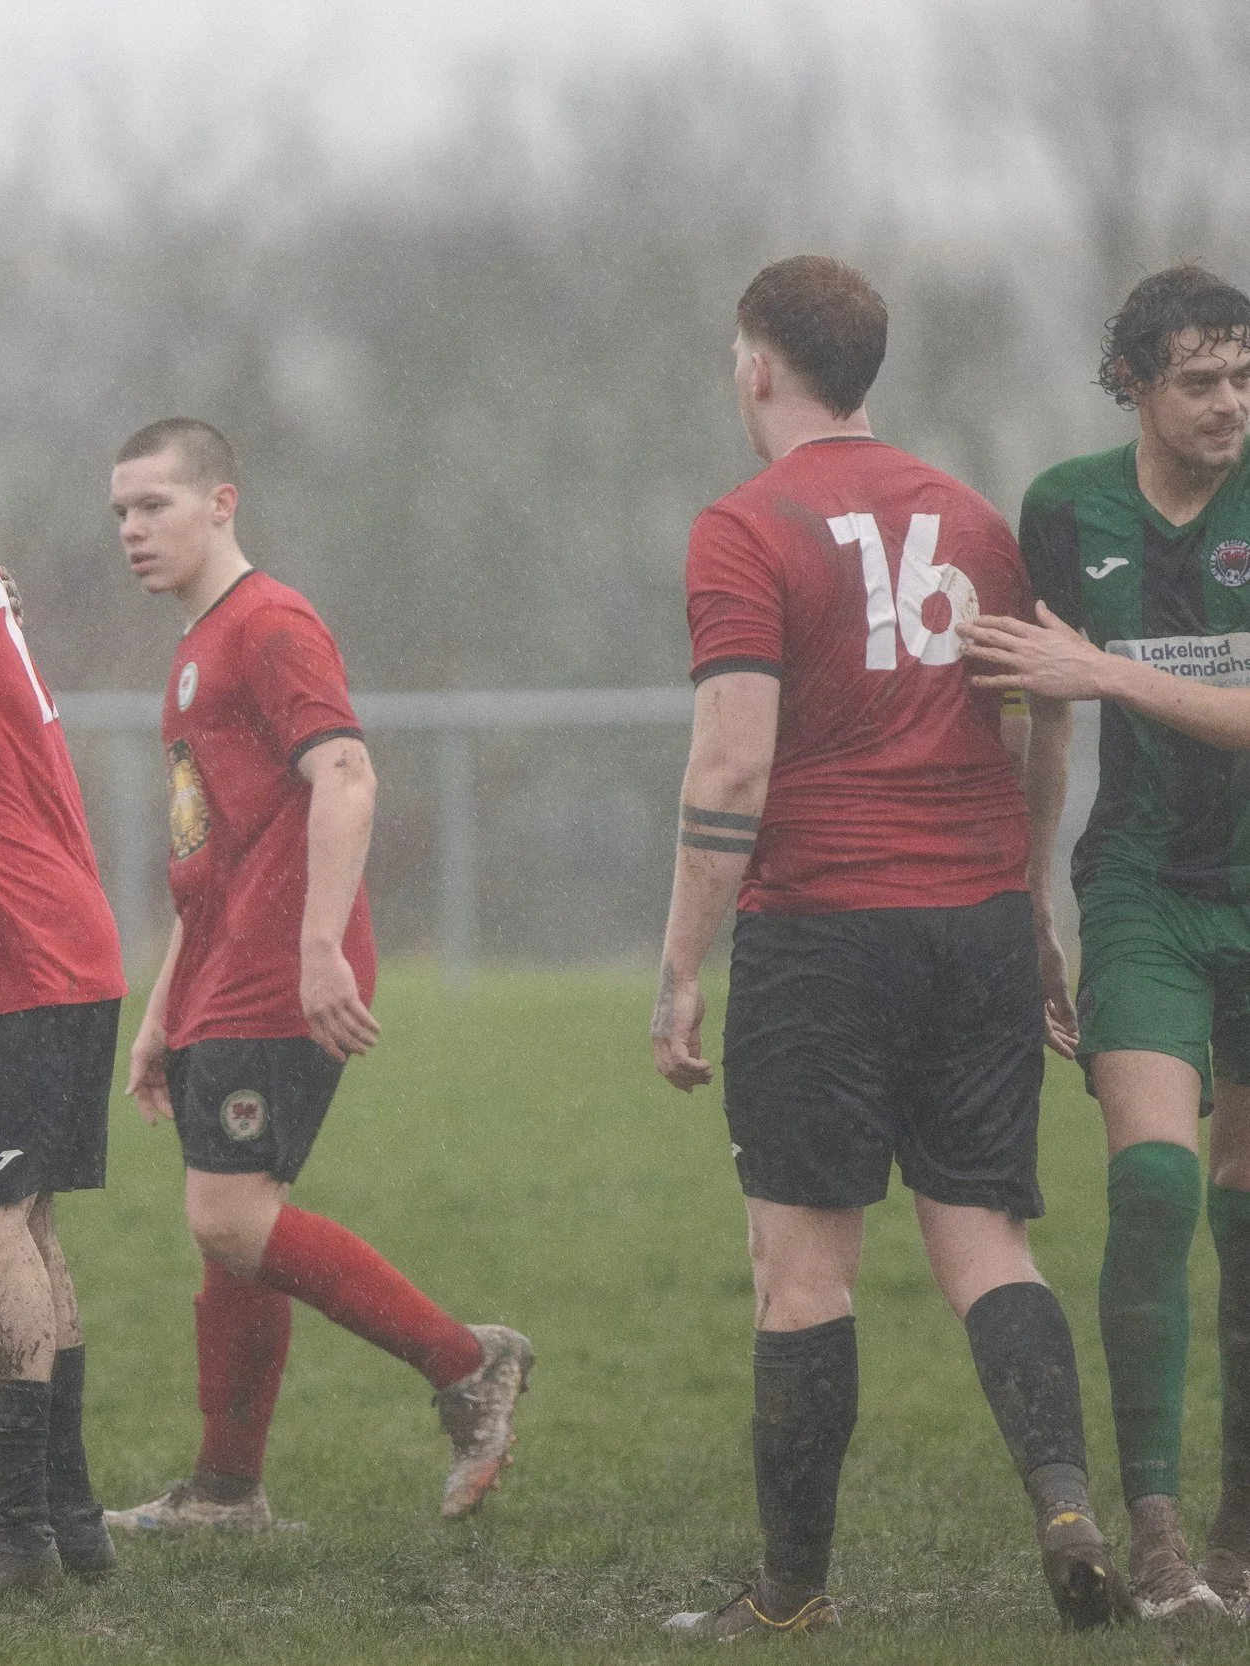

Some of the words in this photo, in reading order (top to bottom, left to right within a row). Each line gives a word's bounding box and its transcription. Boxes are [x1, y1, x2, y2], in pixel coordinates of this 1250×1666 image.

[826, 512, 980, 670] 16
[1141, 640, 1231, 661] Lakeland
[1153, 657, 1250, 677] randahs
